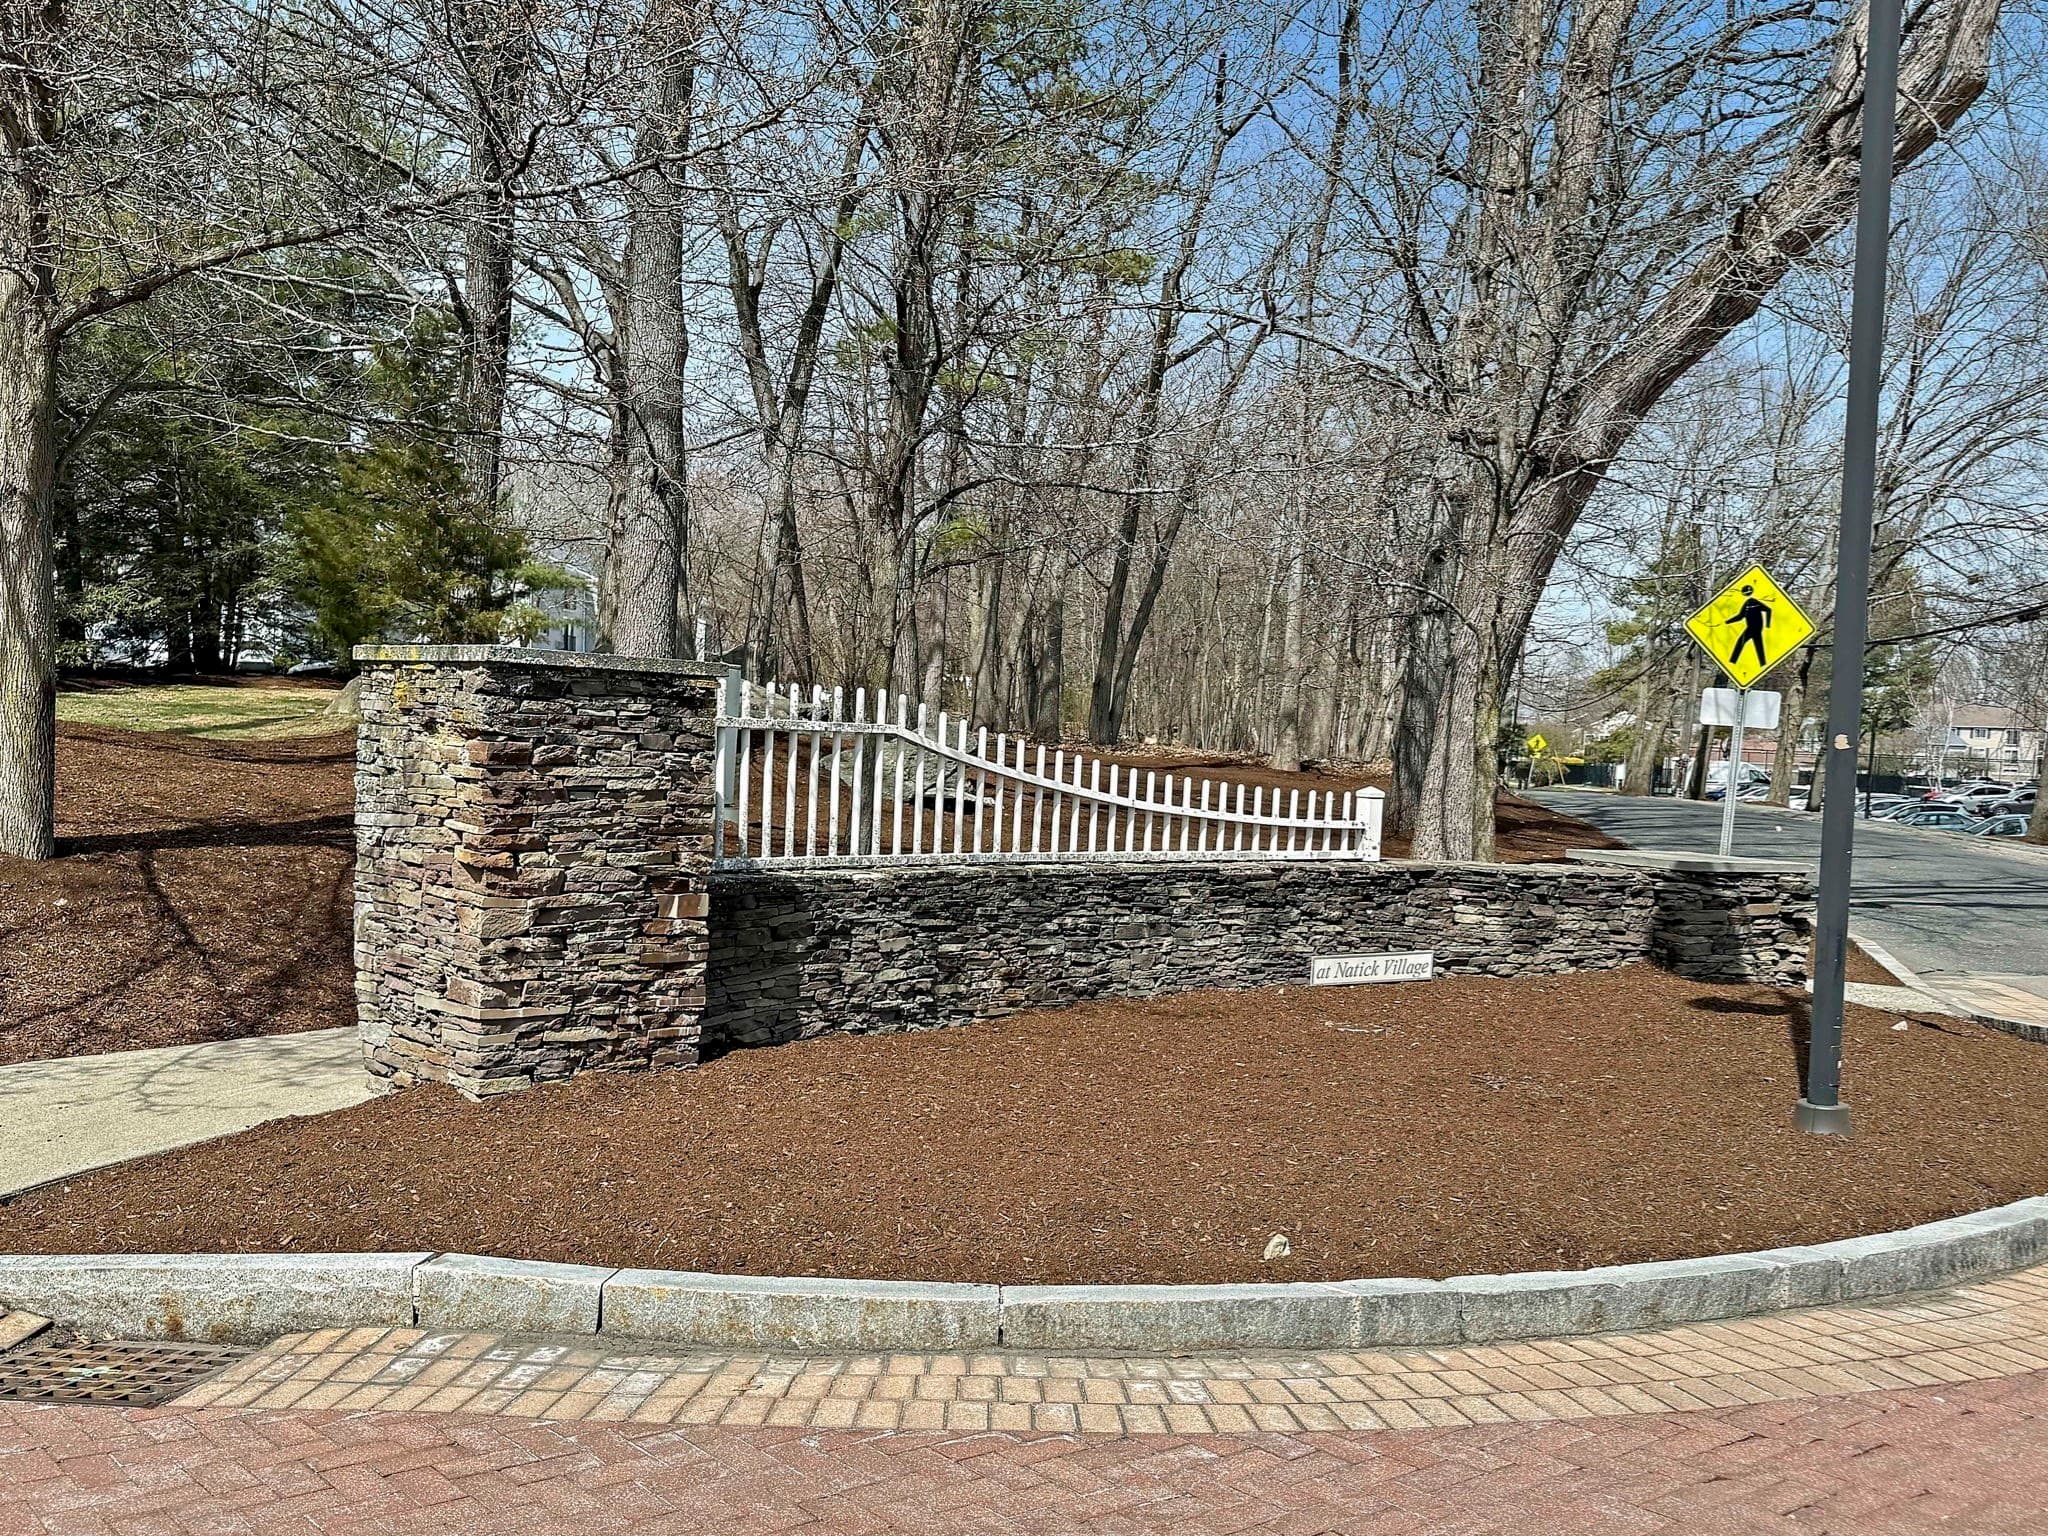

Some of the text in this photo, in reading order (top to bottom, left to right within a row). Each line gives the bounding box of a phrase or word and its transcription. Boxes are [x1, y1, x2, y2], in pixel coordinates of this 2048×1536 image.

[1316, 958, 1429, 979] at Natick Village
